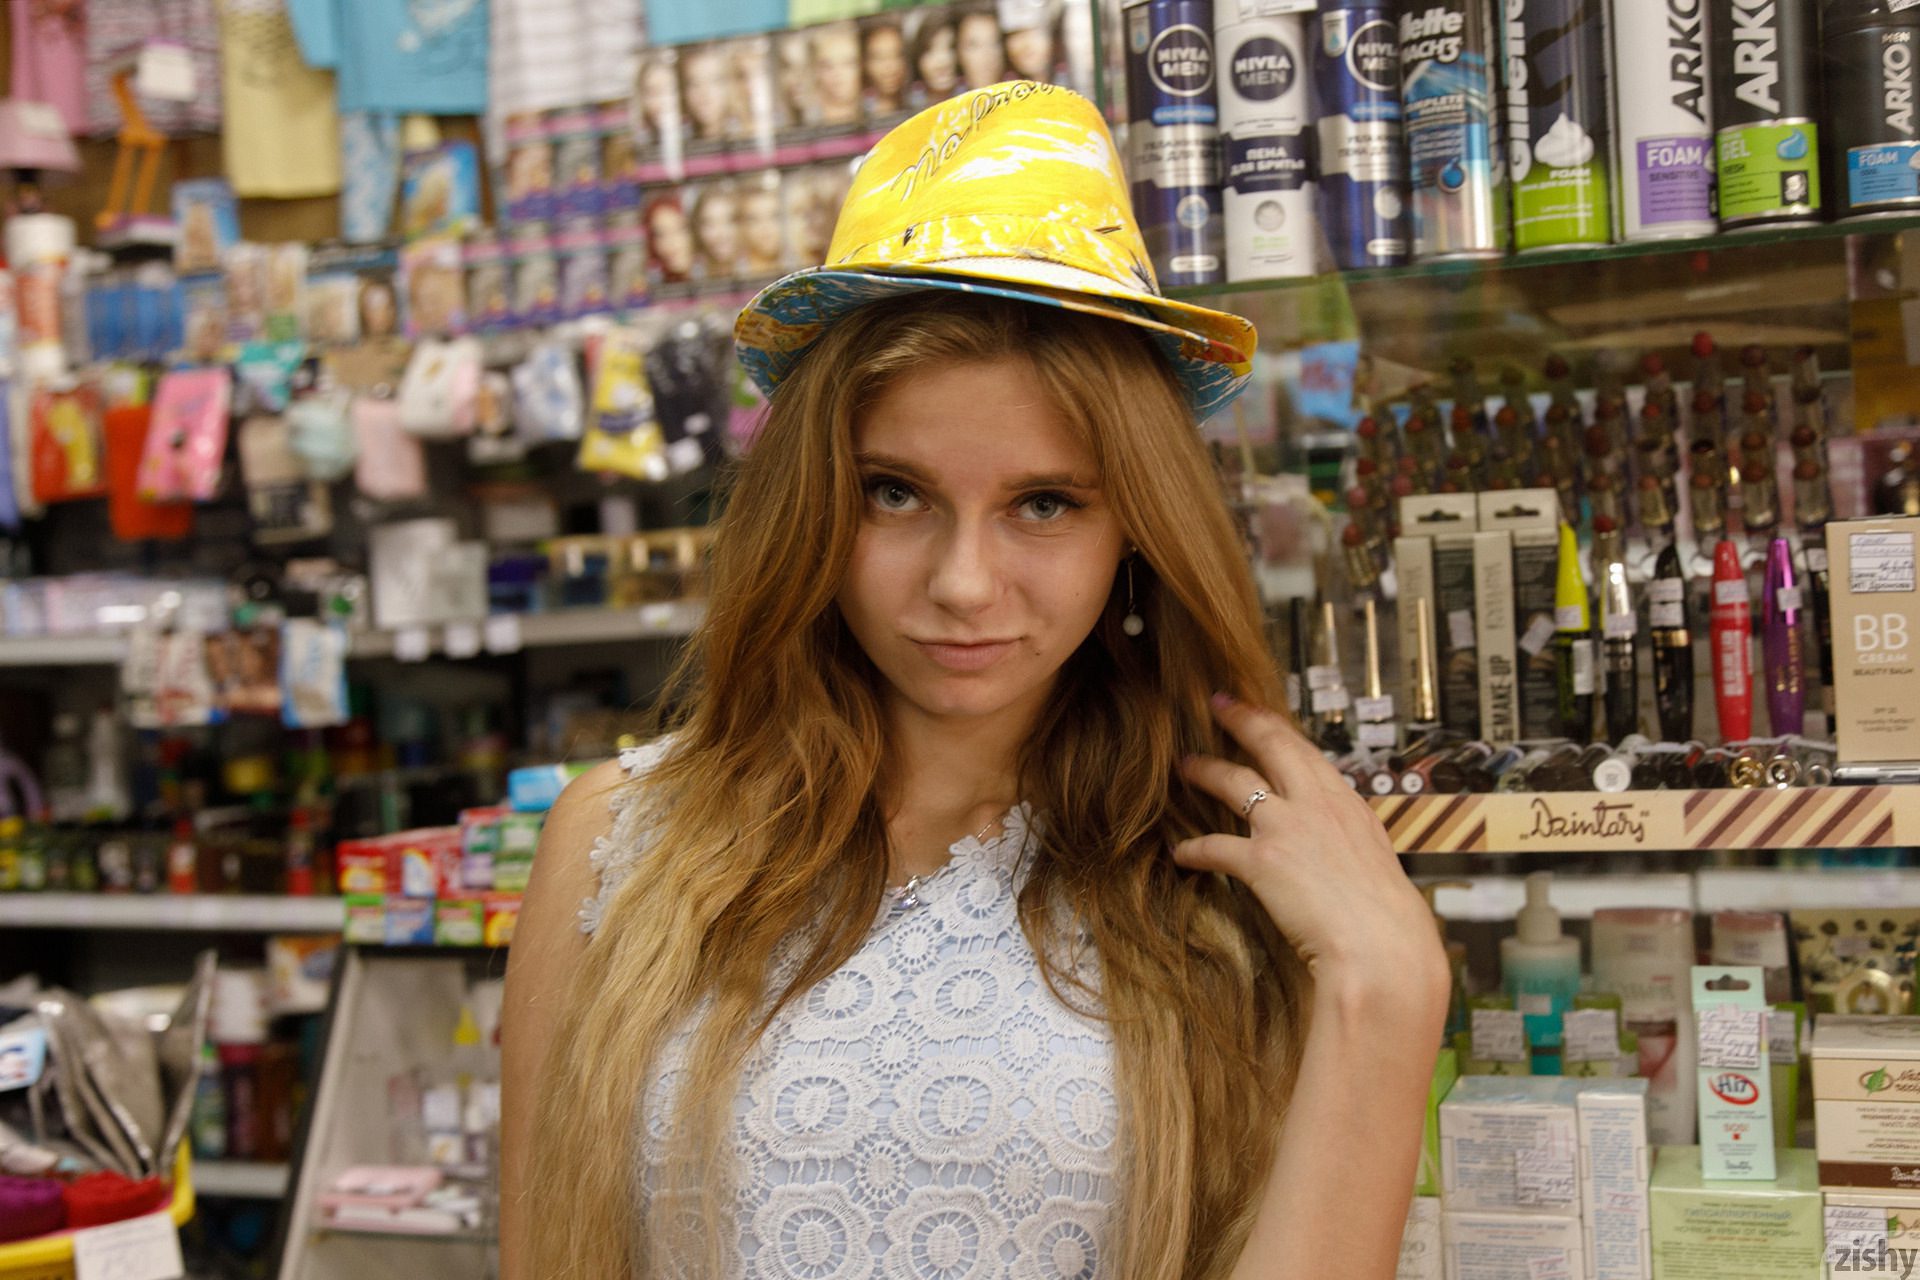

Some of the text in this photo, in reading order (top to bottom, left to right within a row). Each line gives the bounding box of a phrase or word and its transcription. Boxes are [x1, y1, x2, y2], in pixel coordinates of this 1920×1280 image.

[1157, 47, 1209, 62] NIVEA
[1731, 0, 1780, 114] ARK
[1162, 61, 1206, 77] MEN
[1235, 55, 1291, 74] NIVEA
[1240, 69, 1287, 87] MEN
[1883, 43, 1914, 135] ARKO
[1246, 147, 1287, 161] ПЕНА
[1647, 145, 1702, 168] FOAM
[1721, 139, 1752, 161] GEL
[1859, 151, 1898, 167] FOAM
[1549, 168, 1591, 179] FOAM
[1650, 170, 1699, 183] SENSITIVE
[1854, 613, 1908, 651] BB
[1858, 653, 1907, 665] CREAM
